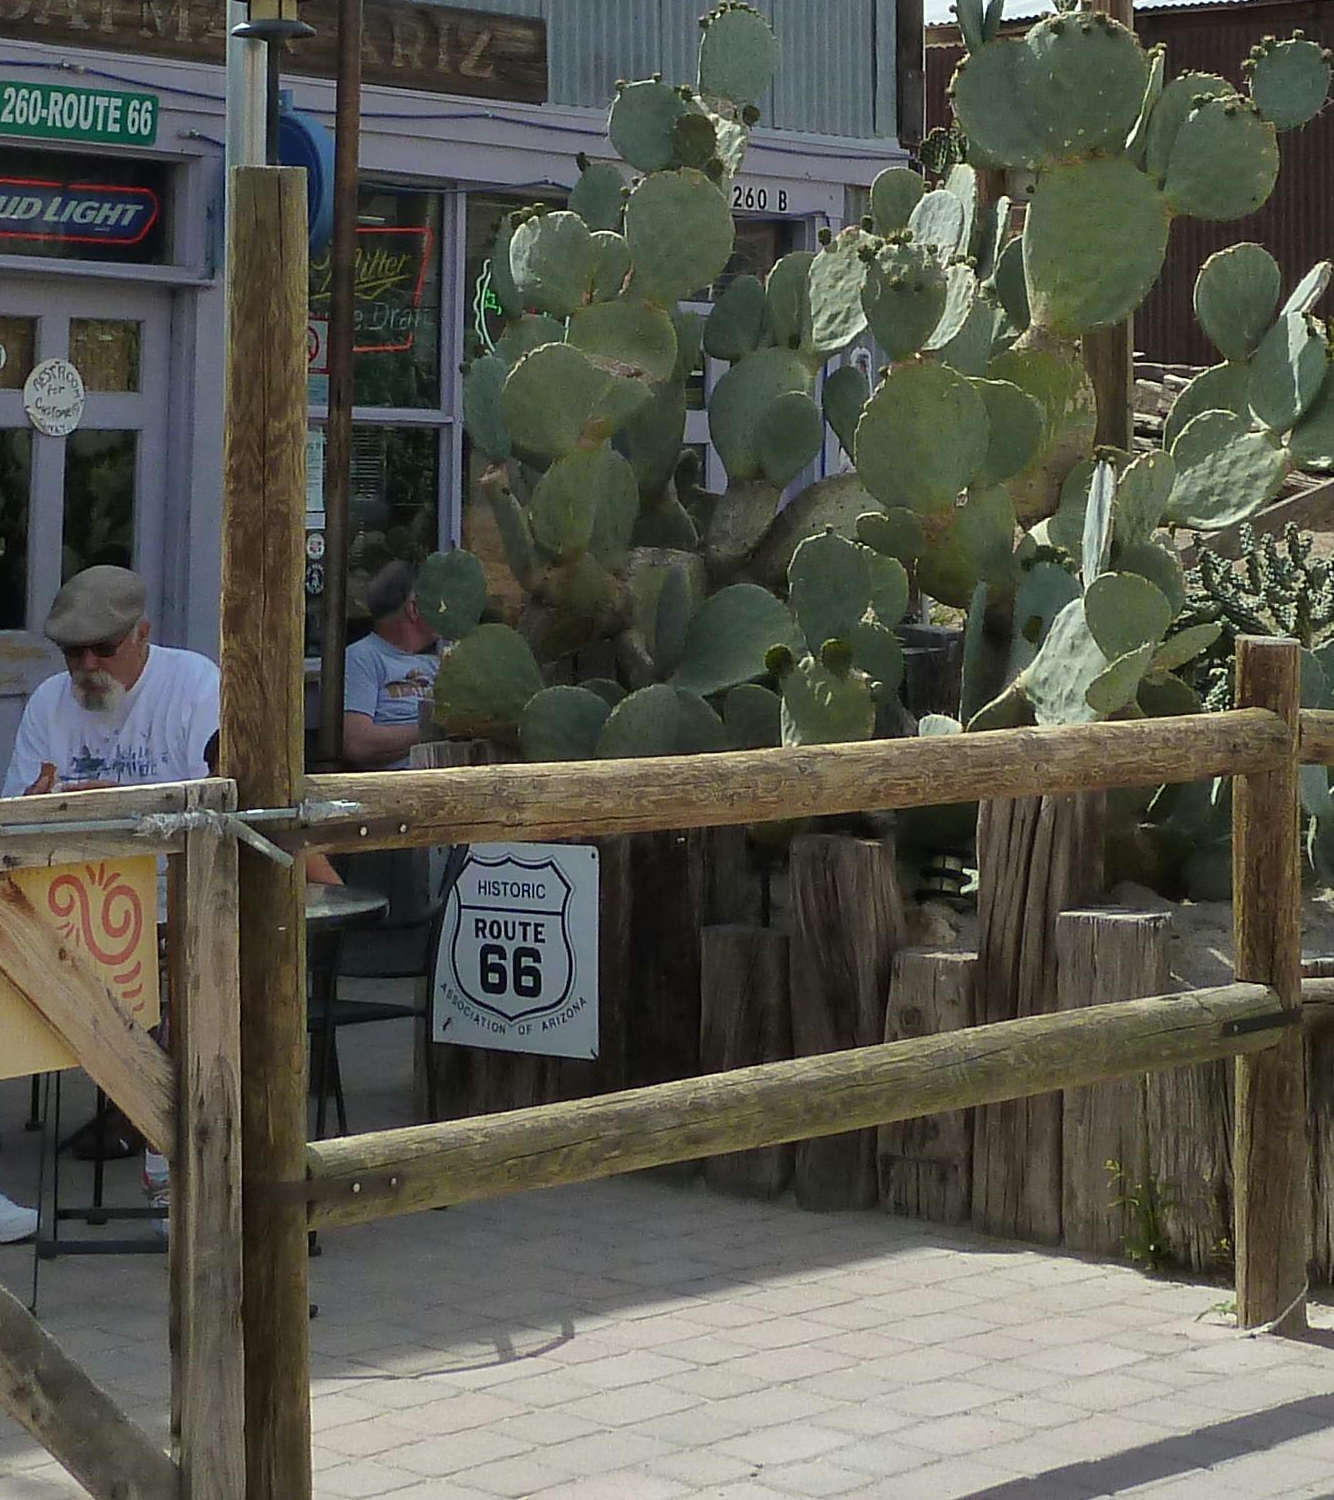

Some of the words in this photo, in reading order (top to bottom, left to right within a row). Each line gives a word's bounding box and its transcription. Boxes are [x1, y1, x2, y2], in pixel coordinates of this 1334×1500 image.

[0, 87, 123, 133] 260-ROUTE
[127, 99, 153, 136] 66
[43, 196, 144, 227] LIGHT
[733, 185, 768, 210] 260
[779, 189, 788, 212] B
[477, 879, 547, 900] HISTORIC
[474, 917, 547, 944] ROUTE
[479, 943, 543, 999] 66
[440, 982, 507, 1036] ASSOCIATION
[517, 1024, 534, 1036] OF
[541, 996, 588, 1032] ARIZONA
